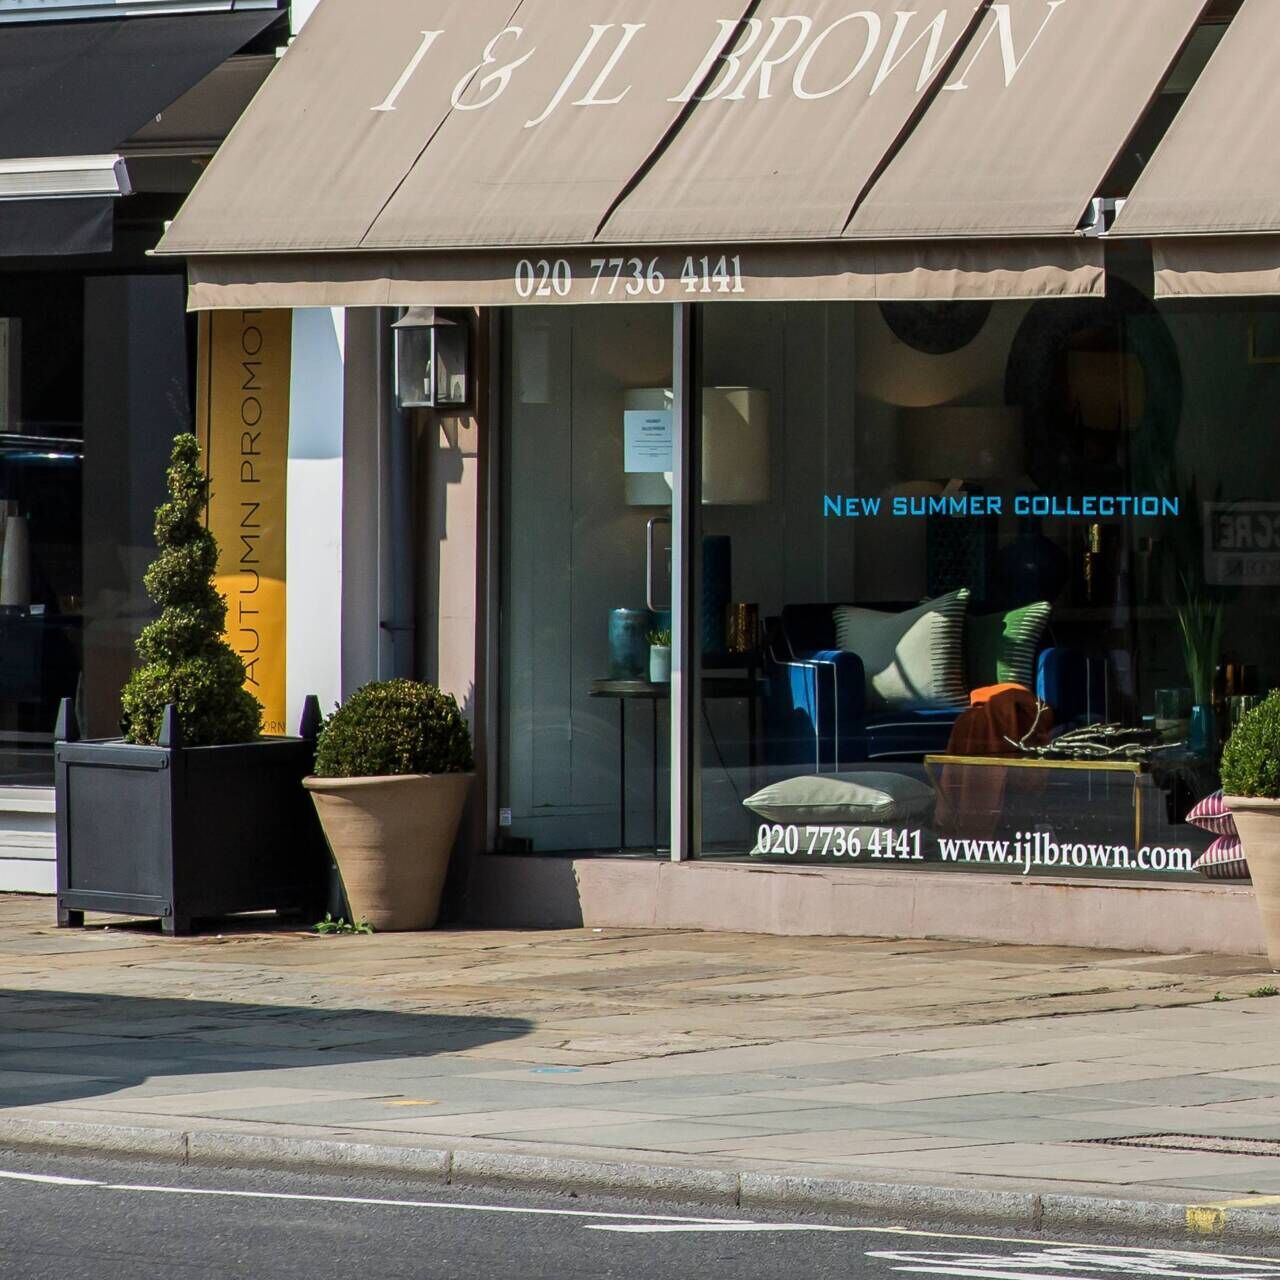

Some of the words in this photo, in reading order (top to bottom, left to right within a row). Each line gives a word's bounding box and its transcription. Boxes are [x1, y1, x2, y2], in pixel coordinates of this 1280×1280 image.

[370, 30, 446, 111] I
[450, 26, 537, 110] &
[523, 23, 647, 128] JL
[666, 0, 1066, 103] BROWN
[514, 259, 572, 297] 020
[590, 256, 665, 295] 7736
[680, 255, 745, 293] 4141
[824, 494, 881, 516] NEW
[892, 495, 1002, 516] SUMMER
[1015, 495, 1180, 516] COLLECTION
[239, 502, 261, 686] AUTUMN
[757, 823, 799, 855] 020
[805, 825, 861, 858] 7736
[867, 829, 924, 861] 4141
[938, 832, 1194, 875] www.ijlbrown.com
